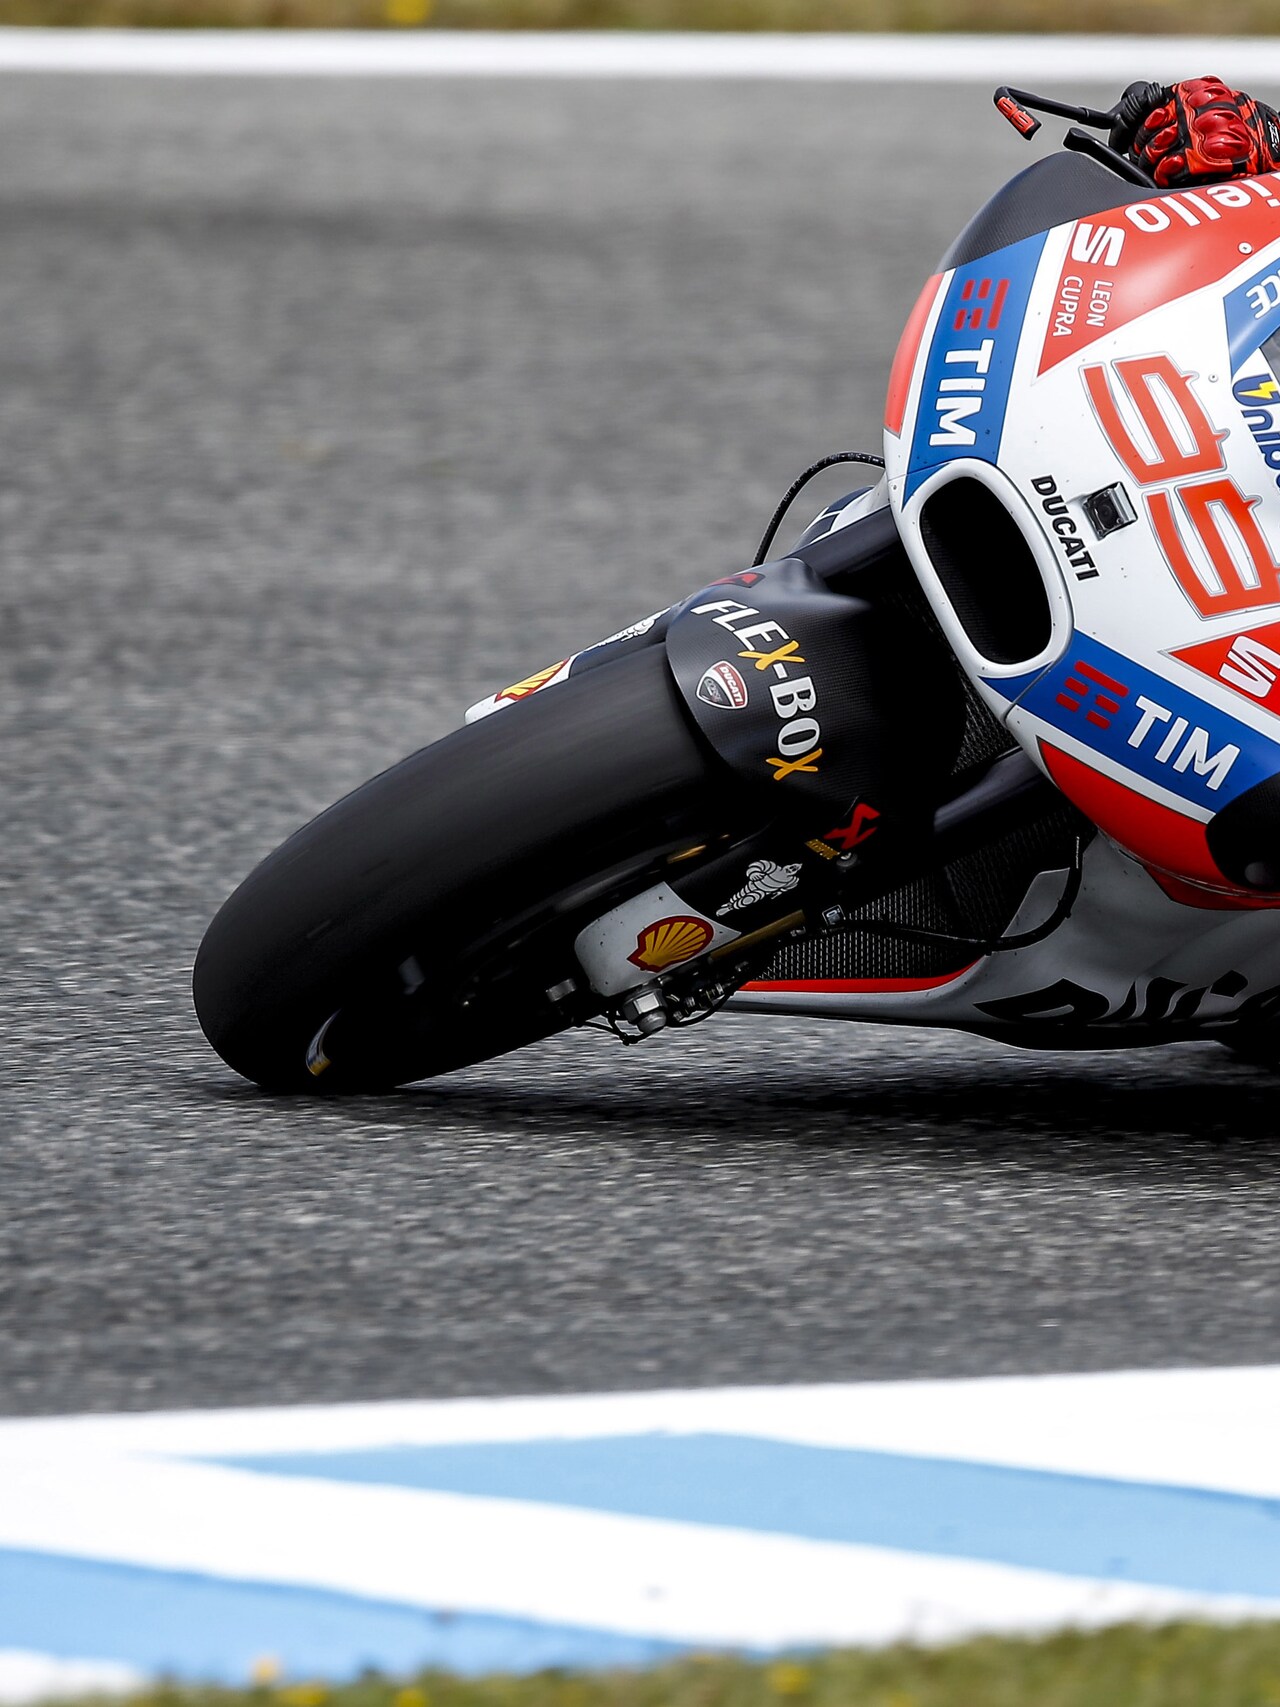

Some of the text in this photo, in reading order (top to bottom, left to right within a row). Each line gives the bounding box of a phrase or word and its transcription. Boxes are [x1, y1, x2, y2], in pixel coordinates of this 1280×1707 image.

[1052, 275, 1083, 337] CUPRA
[1086, 280, 1114, 327] LEON
[929, 338, 995, 446] TIM
[1030, 474, 1101, 582] DUCATI
[690, 599, 823, 781] FLEX-BOX
[719, 666, 744, 702] DUCATI
[1127, 695, 1241, 791] TIM
